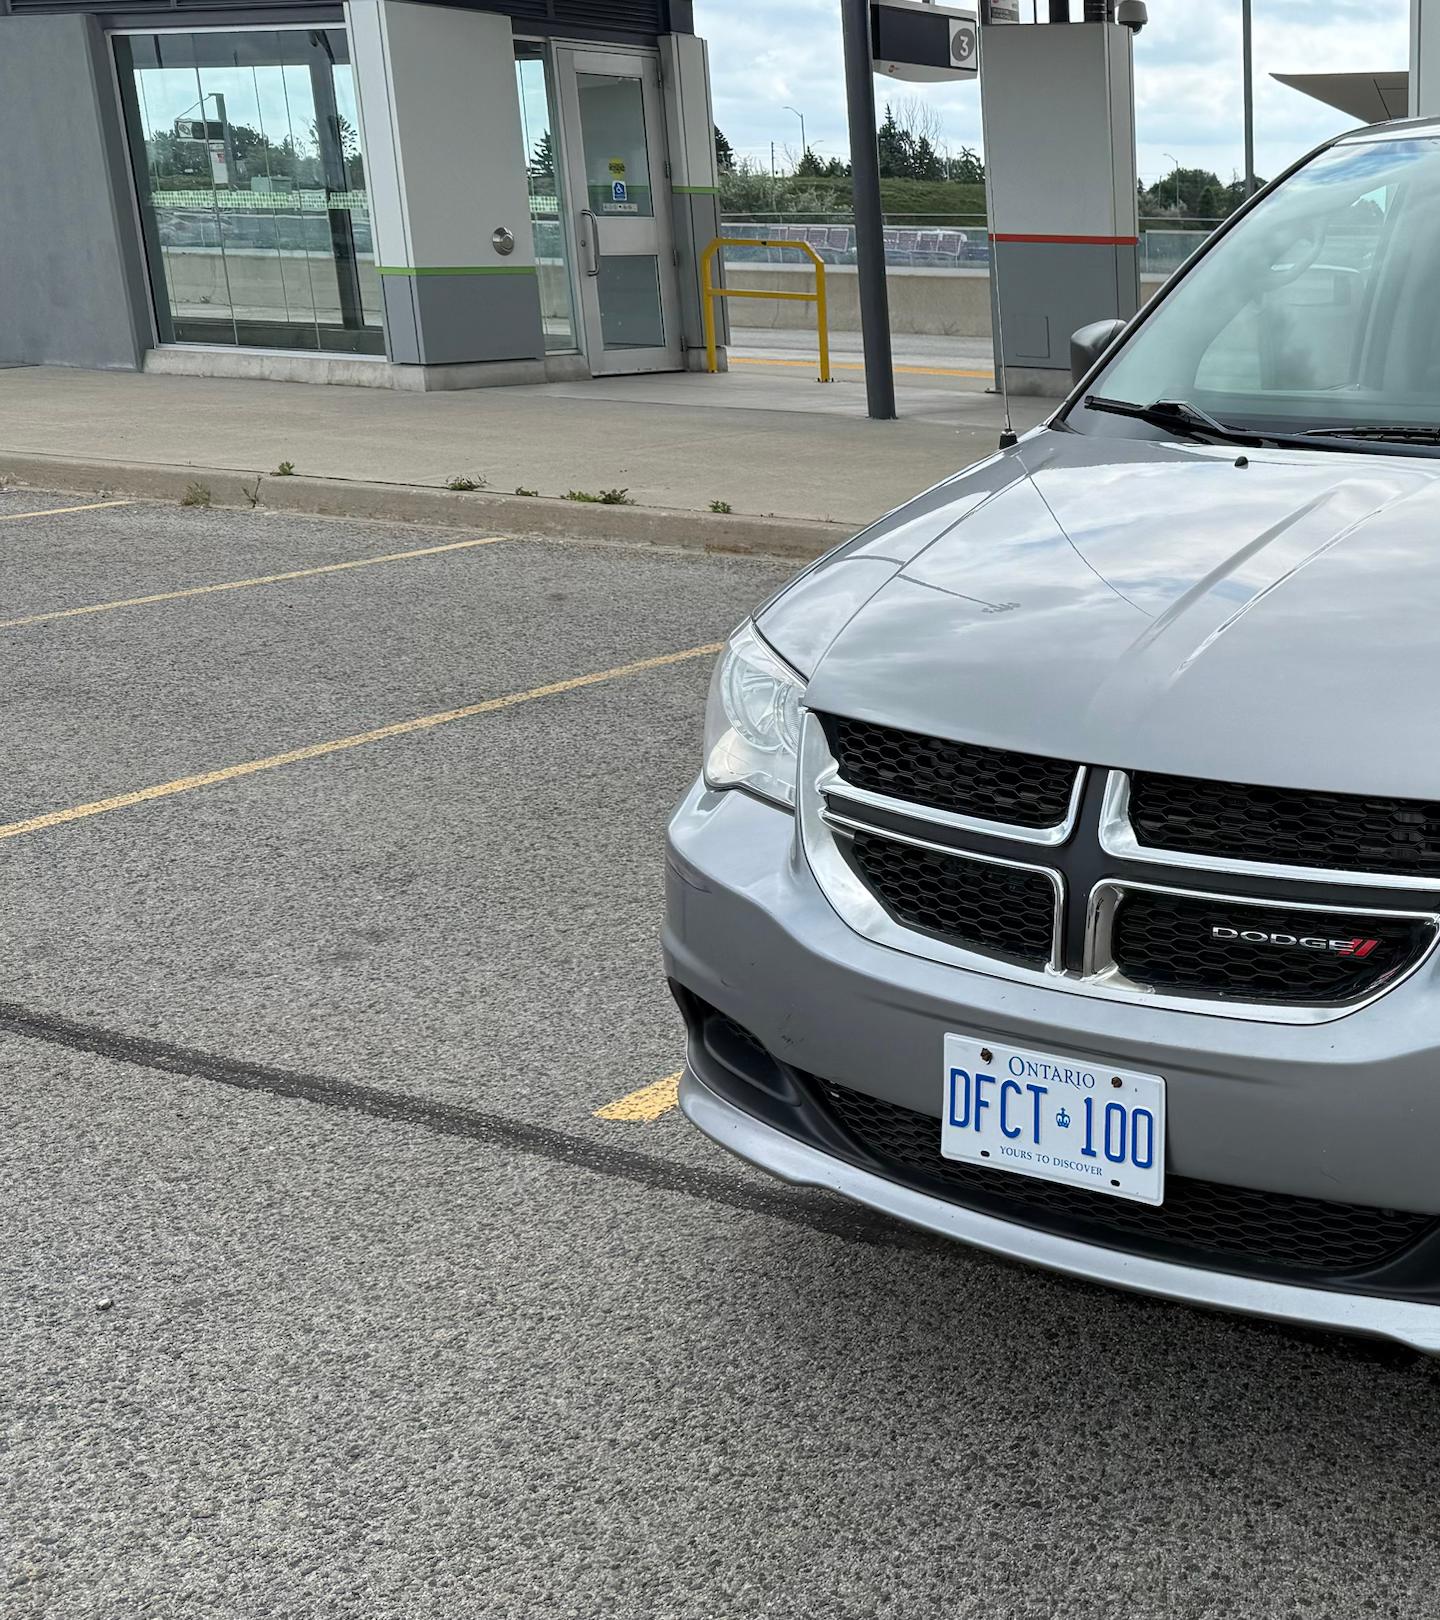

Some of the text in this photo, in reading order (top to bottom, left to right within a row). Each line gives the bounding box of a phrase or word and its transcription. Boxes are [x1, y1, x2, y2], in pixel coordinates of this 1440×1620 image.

[960, 35, 969, 57] 3
[1212, 926, 1355, 952] DODGE
[949, 1067, 1154, 1169] DFCT 100
[1000, 1145, 1103, 1177] YOURS TO DISCOVER
